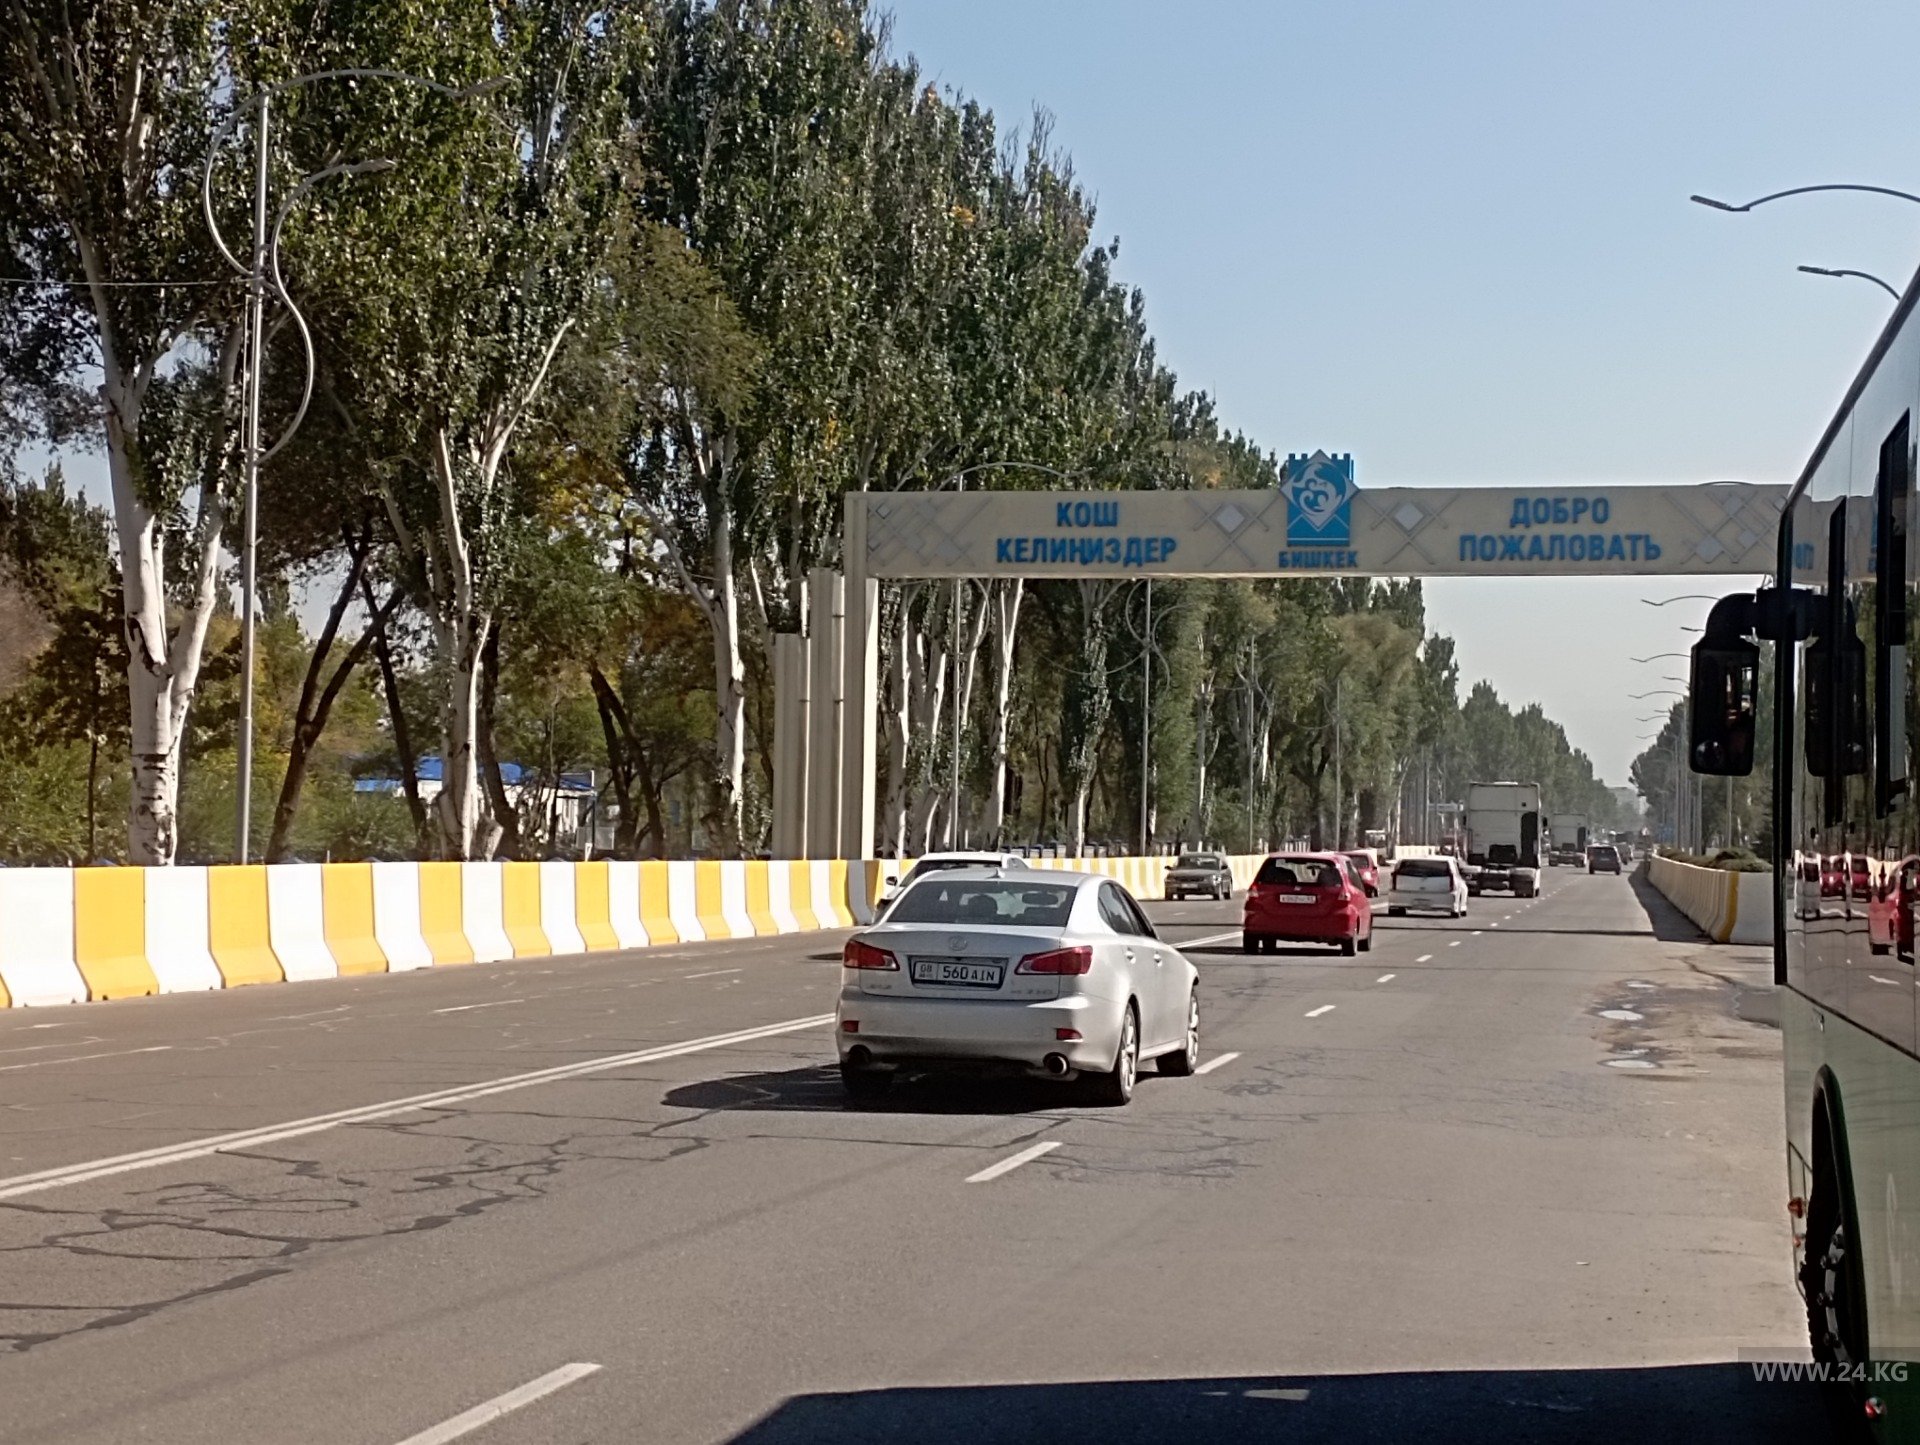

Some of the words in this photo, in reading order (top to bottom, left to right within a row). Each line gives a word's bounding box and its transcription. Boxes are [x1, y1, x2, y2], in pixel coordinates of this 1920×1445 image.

[1056, 501, 1119, 528] КОШ
[1509, 497, 1610, 529] ДОБРО
[996, 536, 1177, 568] КЕЛИҢИЗДЕР
[1278, 550, 1358, 568] БИШКЕК
[1459, 534, 1661, 562] ПОЖАЛОВАТЬ
[943, 965, 969, 979] 560
